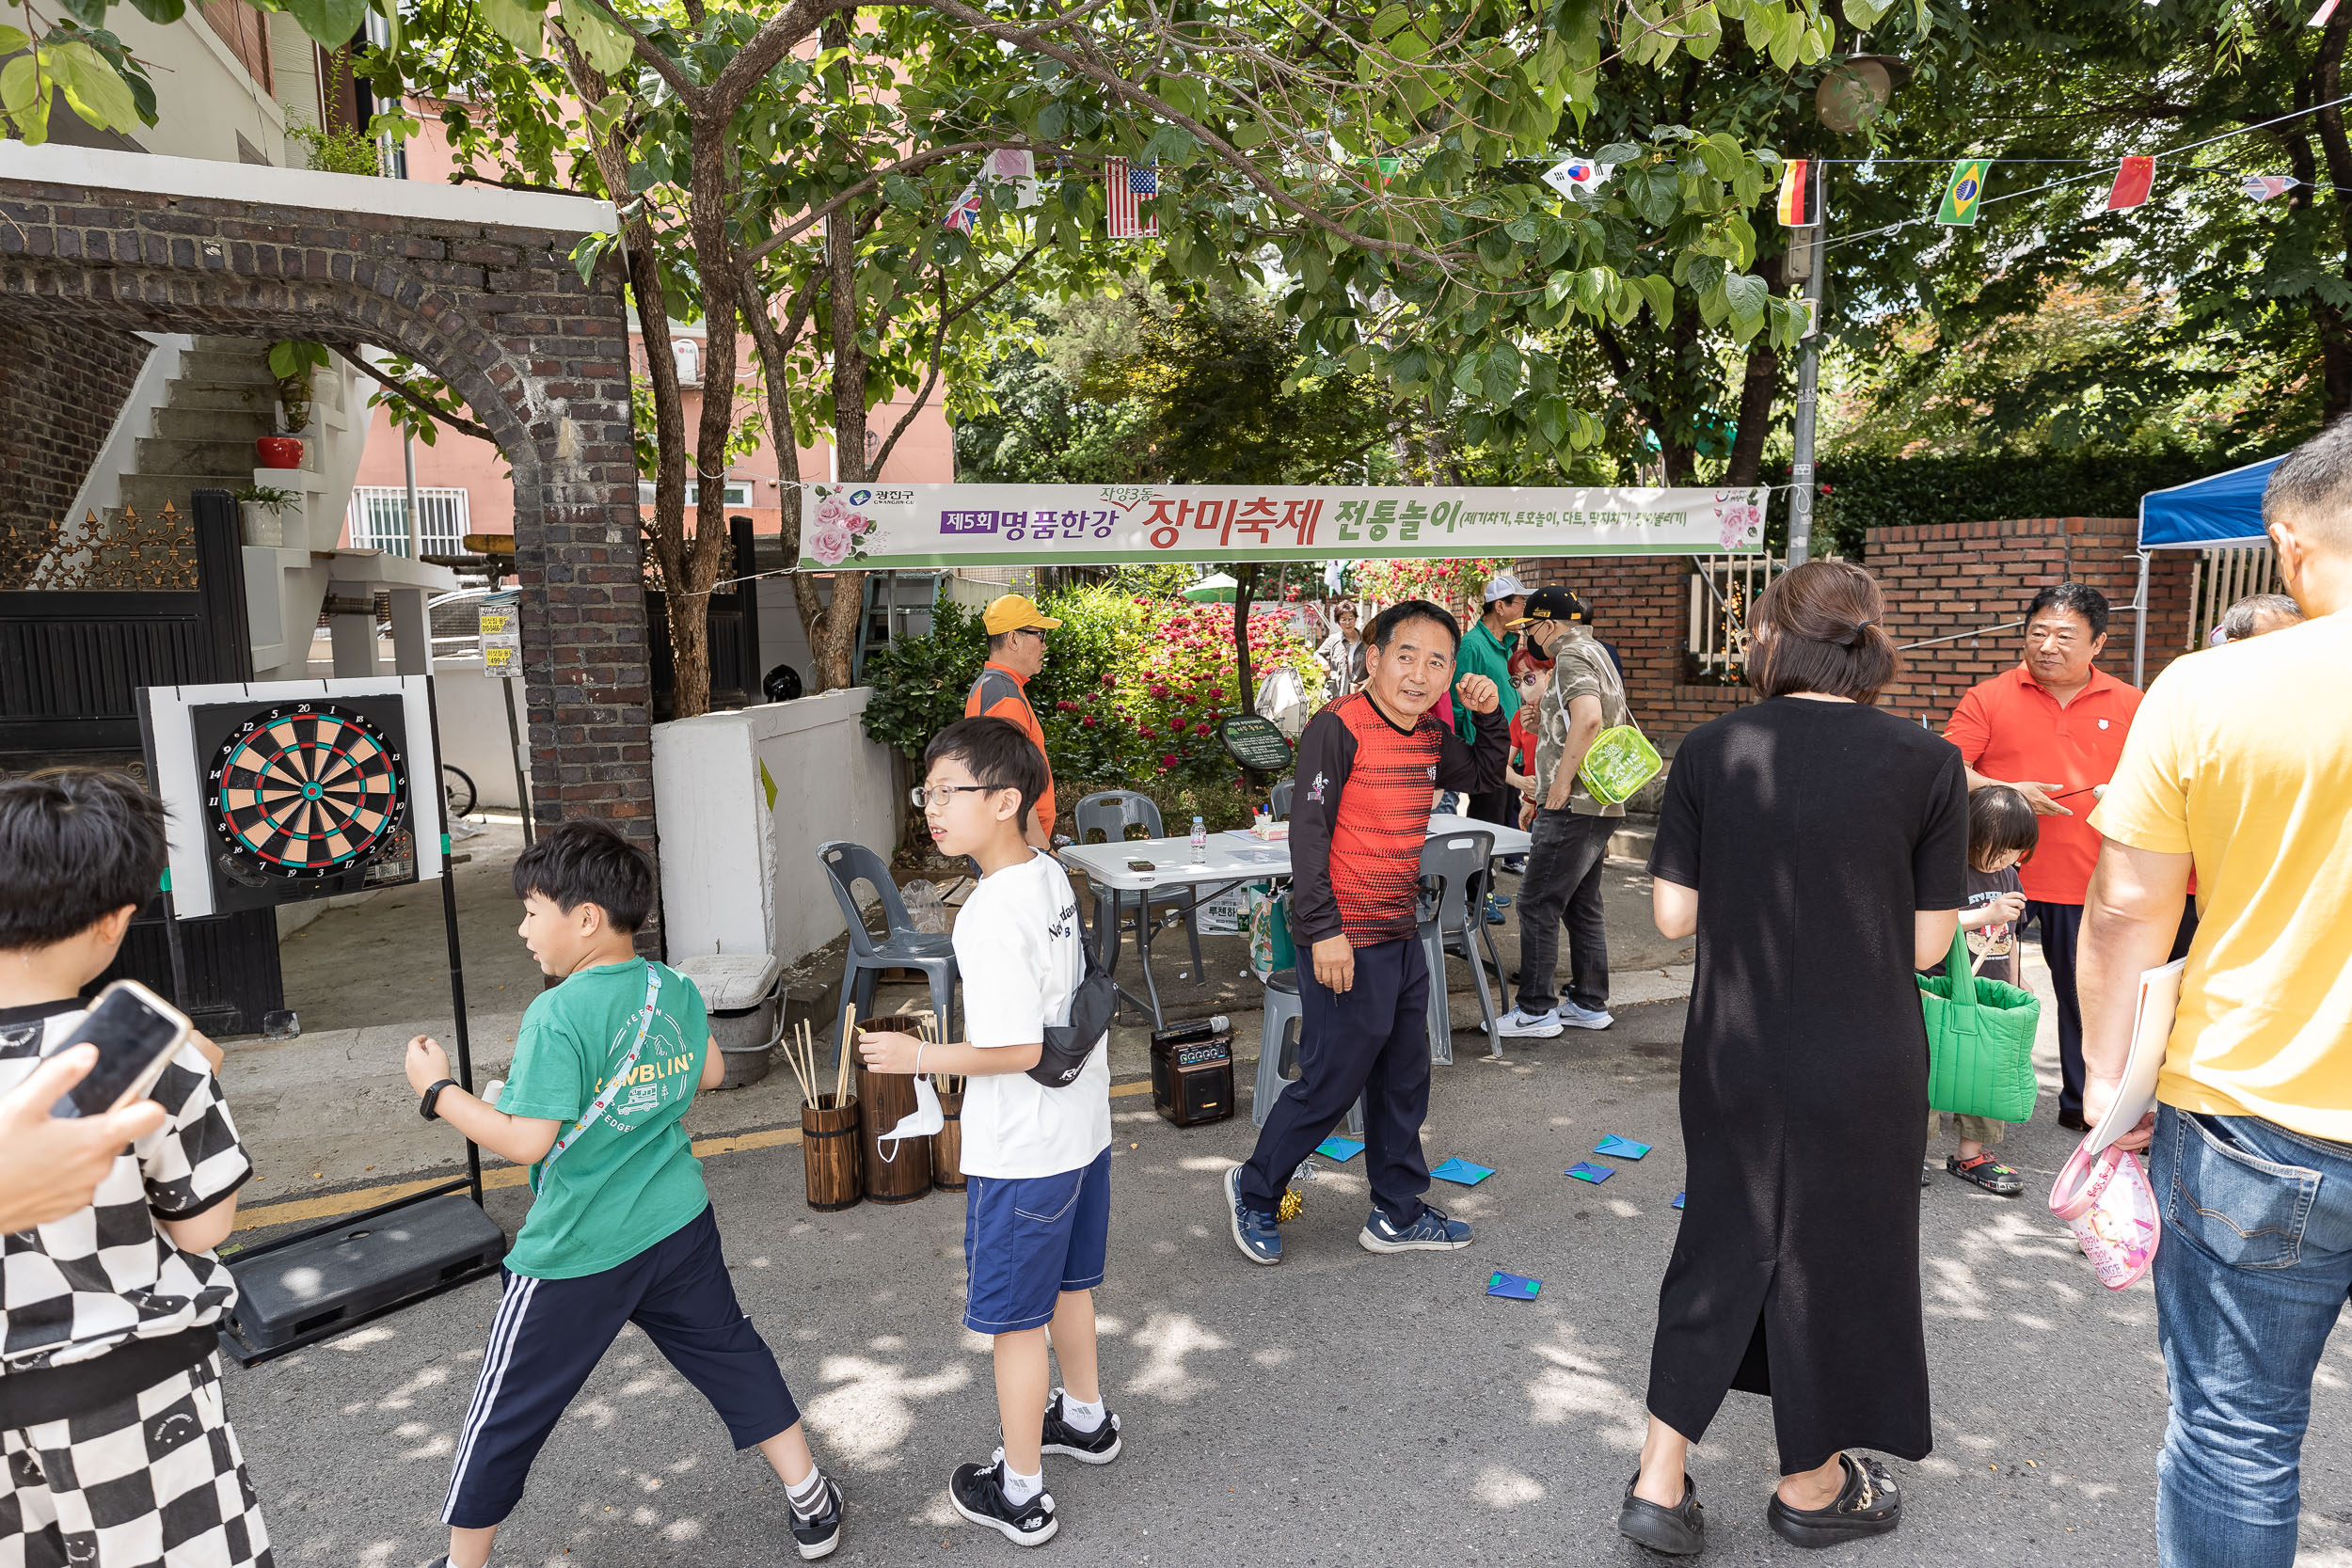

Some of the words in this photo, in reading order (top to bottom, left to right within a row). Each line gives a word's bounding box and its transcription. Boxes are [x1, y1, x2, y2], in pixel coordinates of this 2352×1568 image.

[875, 490, 914, 499] 광진구
[1100, 487, 1153, 501] 자양3동
[946, 512, 993, 531] 제5회
[1001, 511, 1120, 541] 명품한강
[1142, 497, 1325, 548] 장미축제
[1335, 500, 1463, 541] 전통놀이
[297, 705, 310, 713] 20
[329, 705, 336, 714] 1
[270, 709, 278, 719] 5
[356, 715, 364, 723] 18
[242, 722, 254, 732] 12
[376, 733, 384, 741] 4
[223, 746, 231, 754] 9
[209, 770, 221, 780] 14
[398, 777, 405, 785] 6
[208, 798, 218, 806] 11
[395, 801, 405, 810] 10
[218, 823, 226, 832] 8
[386, 825, 396, 833] 15
[232, 846, 243, 854] 16
[369, 846, 375, 854] 2
[259, 862, 267, 871] 7
[344, 860, 355, 869] 17
[287, 869, 297, 878] 19
[1209, 907, 1238, 917] 루첸하
[626, 1008, 644, 1027] KEE
